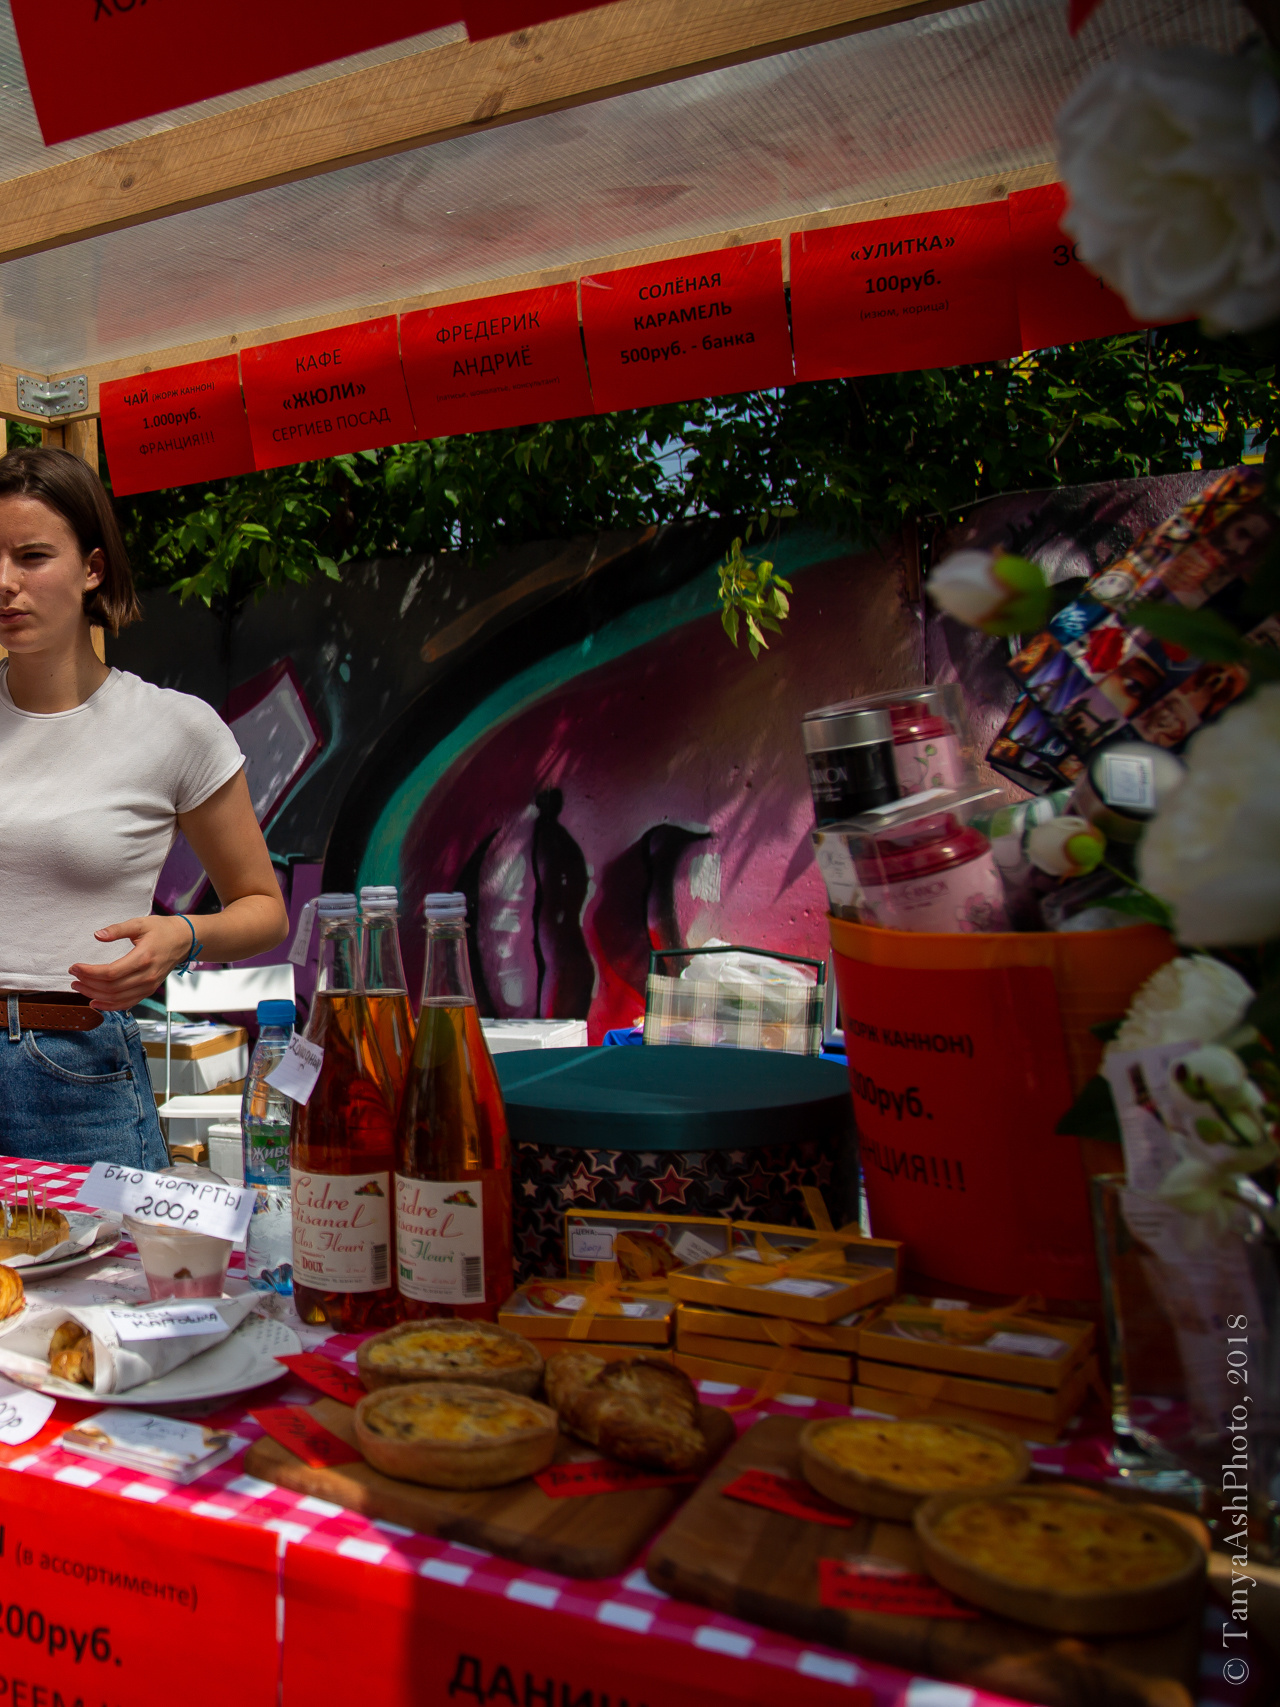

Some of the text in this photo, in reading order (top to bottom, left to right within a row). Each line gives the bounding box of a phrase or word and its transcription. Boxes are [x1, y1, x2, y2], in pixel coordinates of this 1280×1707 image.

[850, 234, 955, 262] «УЛИТКА»
[638, 272, 721, 302] СОЛЁНАЯ
[865, 269, 942, 294] 100руб.
[633, 301, 732, 331] КАРАМЕЛЬ
[902, 299, 950, 317] корица)
[436, 311, 541, 344] ФРЕДЕРИК
[295, 349, 342, 374] КАФЕ
[452, 345, 533, 377] АНДРИЁ
[620, 341, 687, 365] 500руб.
[702, 330, 756, 352] банка
[123, 381, 215, 407] ЧАЙ (ЖОРЖ КАННОН)
[283, 381, 366, 411] «ЖЮЛИ»
[143, 407, 201, 430] 1.000руб.
[272, 407, 391, 443] СЕРГИЕВ ПОСАД
[139, 431, 215, 456] ФРАНЦИЯ!!!
[104, 1165, 144, 1185] БИО
[293, 1176, 350, 1212] Cidre
[292, 1204, 376, 1229] tisanal
[398, 1213, 463, 1239] isanal
[39, 1553, 199, 1613] ассортименте)
